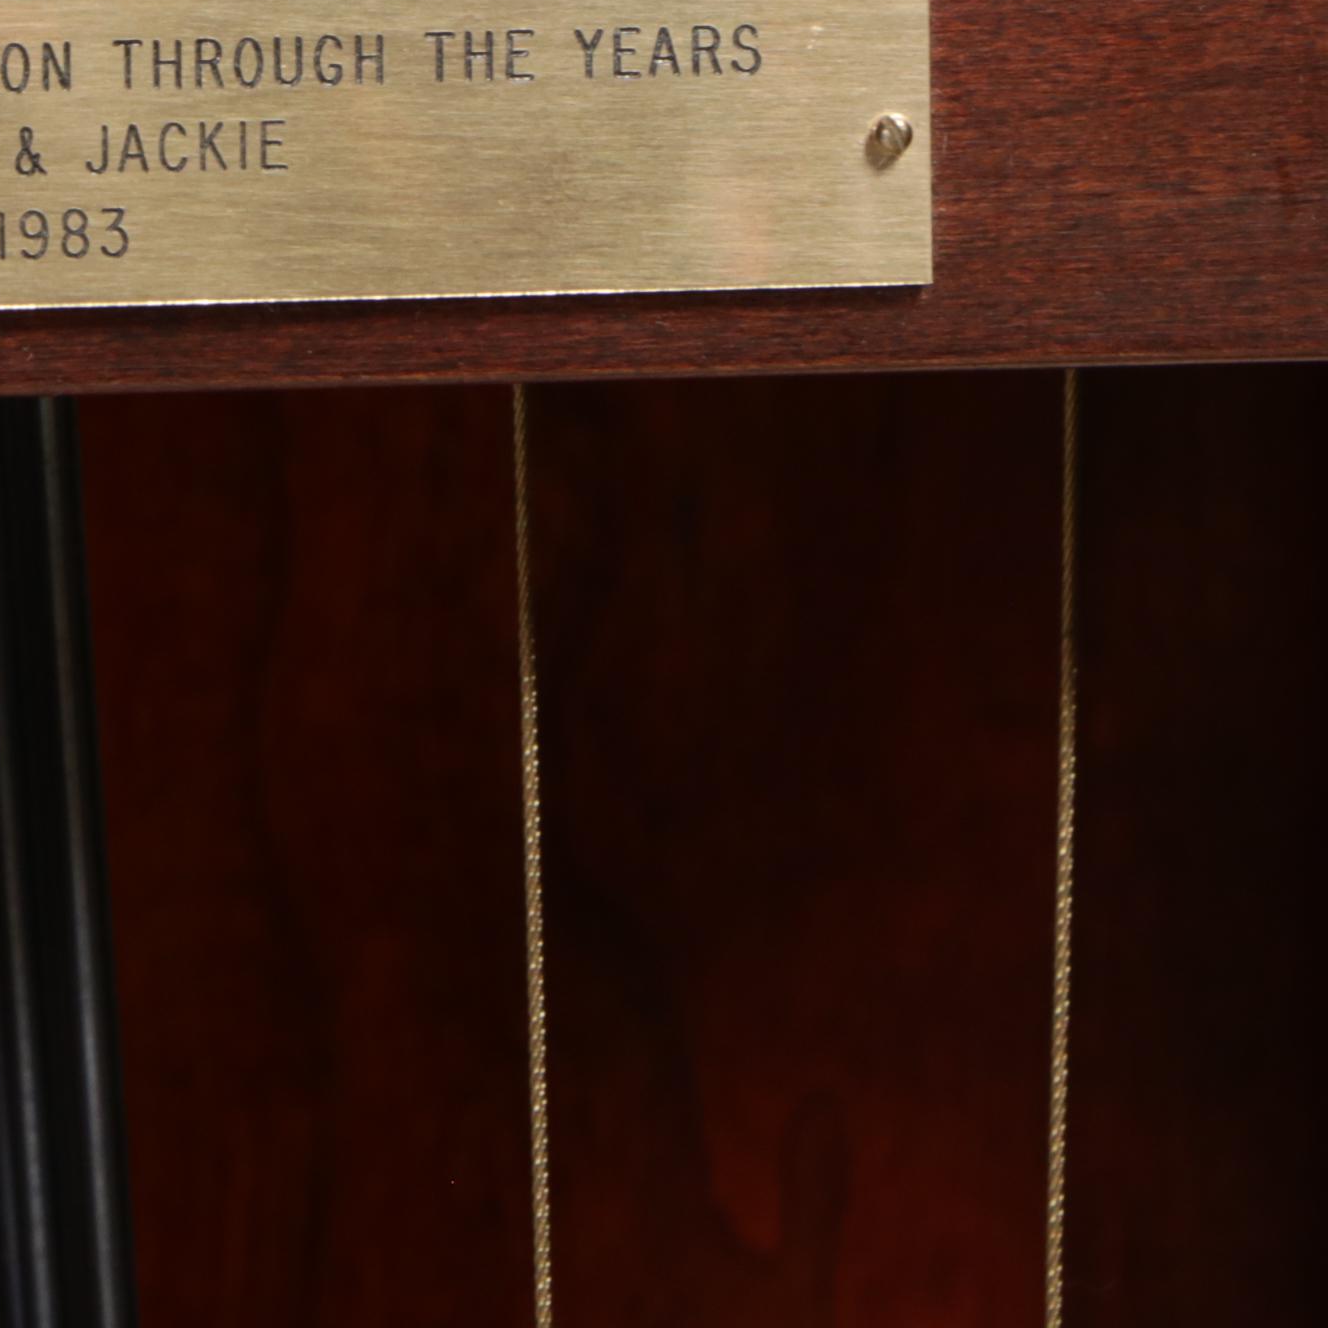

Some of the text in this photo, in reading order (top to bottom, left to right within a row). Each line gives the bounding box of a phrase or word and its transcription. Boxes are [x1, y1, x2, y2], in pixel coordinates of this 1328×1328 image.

[113, 33, 386, 90] THROUGH
[424, 29, 535, 81] THE
[574, 24, 764, 79] YEARS
[14, 127, 48, 176] &
[86, 120, 288, 174] JACKIE
